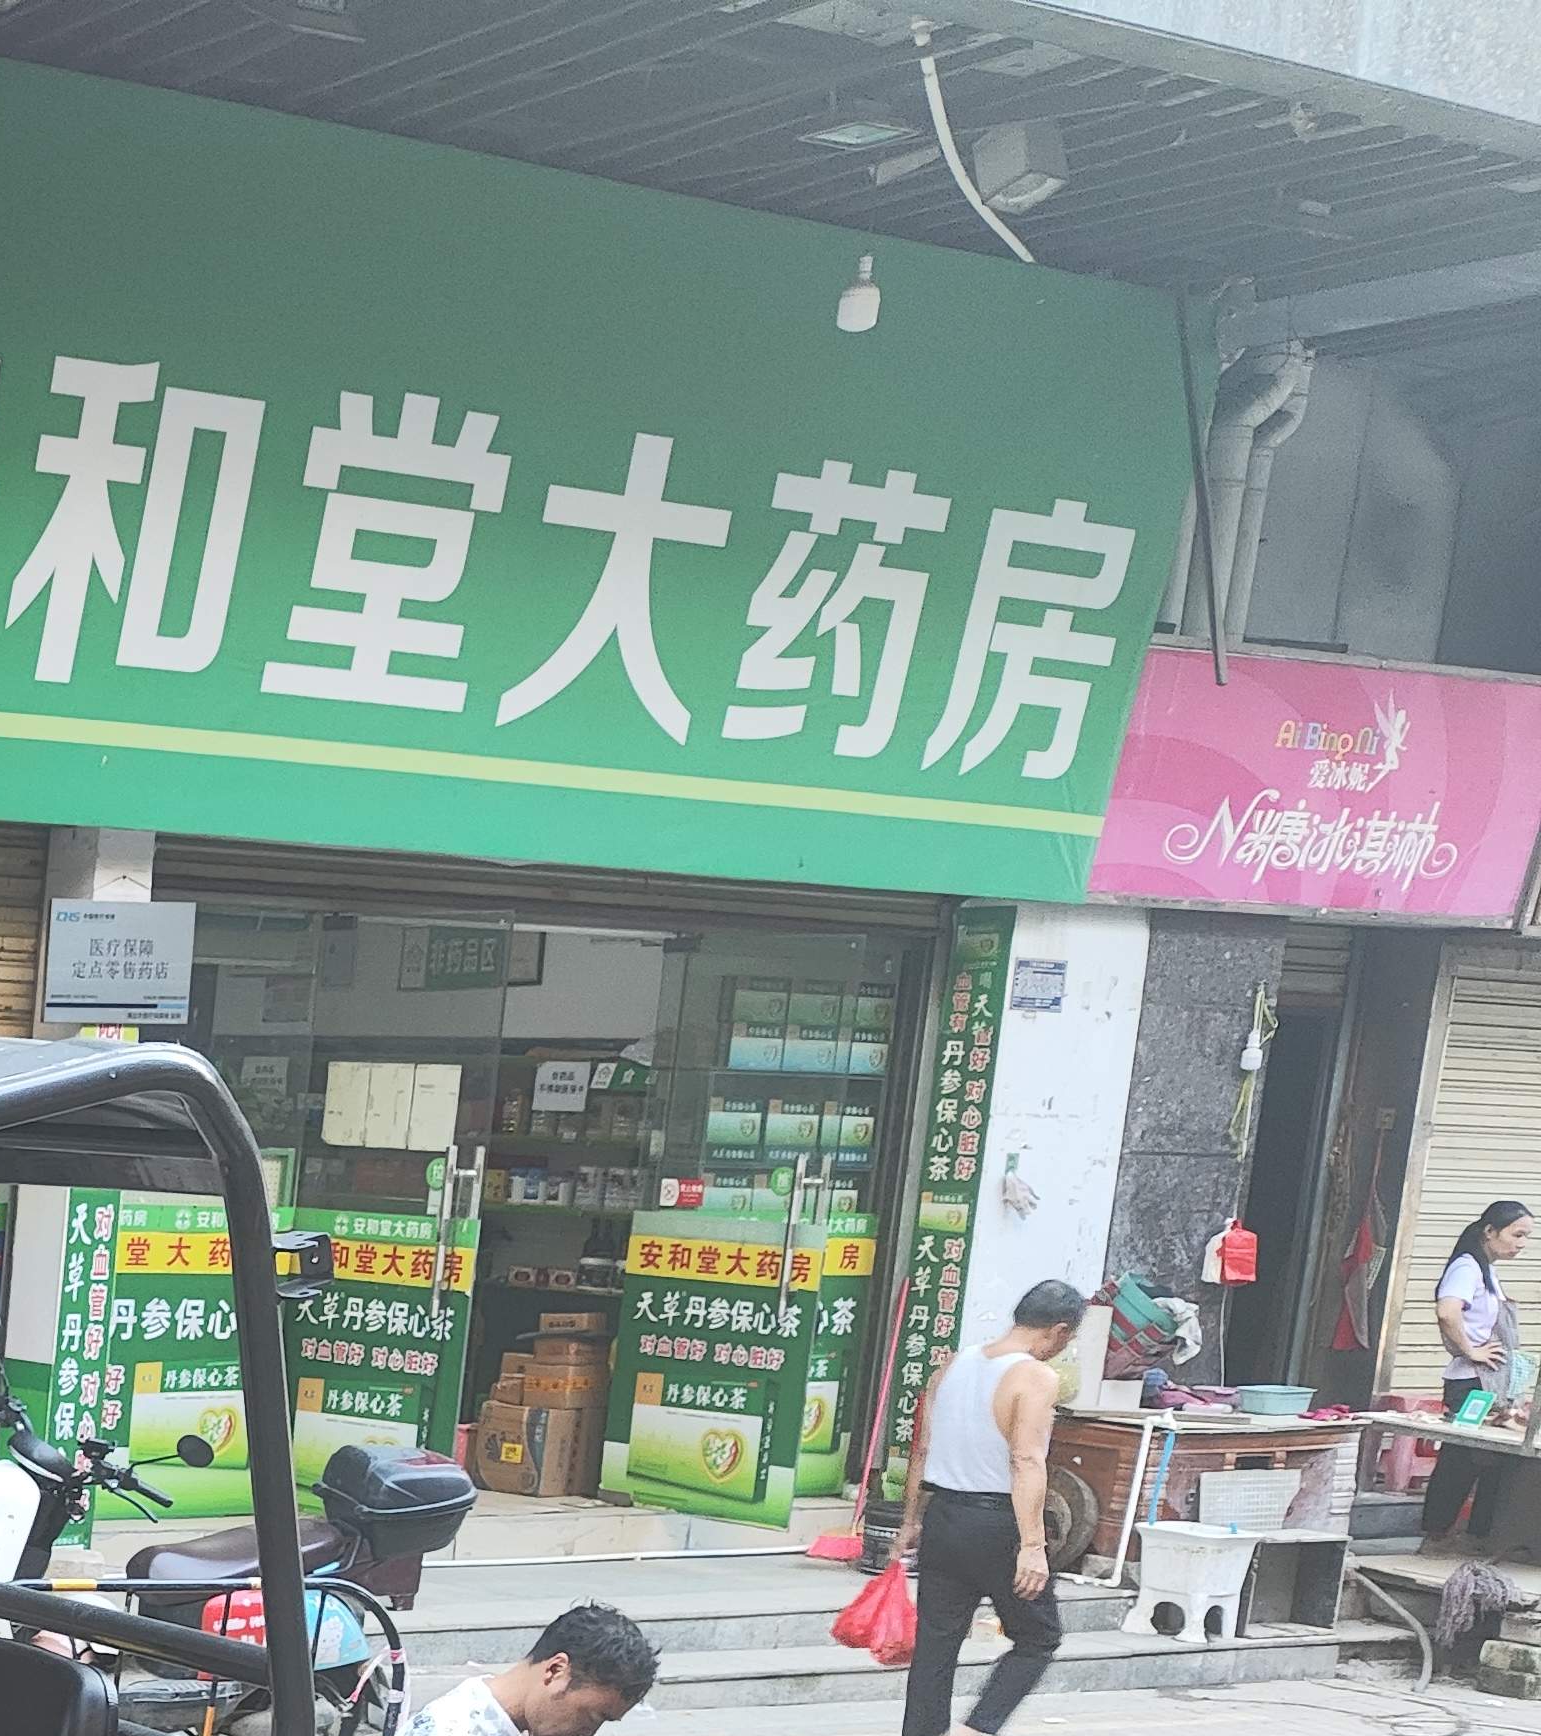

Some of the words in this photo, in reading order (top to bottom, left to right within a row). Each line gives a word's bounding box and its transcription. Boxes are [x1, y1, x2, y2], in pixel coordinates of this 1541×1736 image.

[89, 938, 154, 957] 医疗保障
[72, 960, 169, 980] 定点零售药店
[928, 1040, 966, 1182] 丹参保心茶
[352, 1216, 433, 1239] 安和堂大药房
[125, 1237, 232, 1268] 堂大药
[639, 1239, 811, 1283] 安和堂大药房
[840, 1245, 859, 1270] 房
[54, 1203, 92, 1458] 天草丹参保
[633, 1290, 803, 1338] 天草丹参保心茶
[895, 1234, 940, 1442] 天草丹参保心茶
